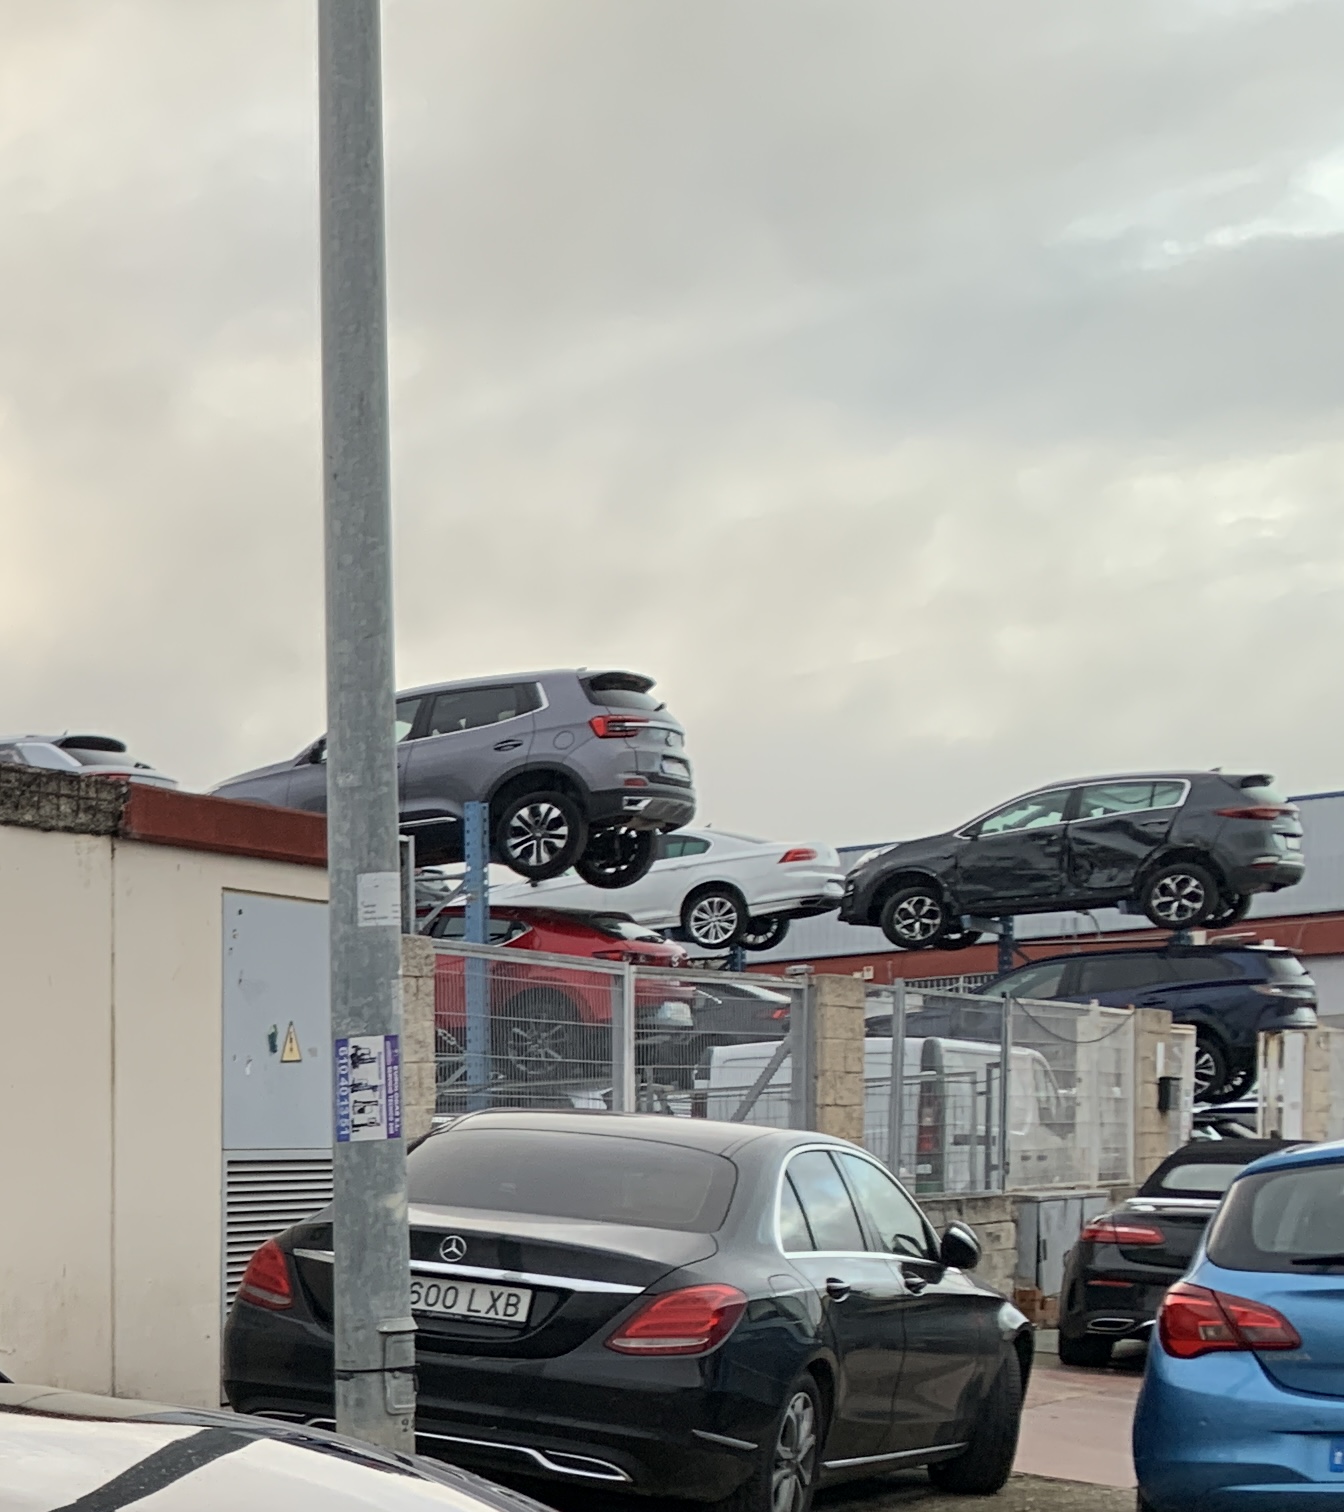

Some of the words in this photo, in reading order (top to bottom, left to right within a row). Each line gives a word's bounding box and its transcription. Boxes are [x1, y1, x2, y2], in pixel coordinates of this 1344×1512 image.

[338, 1046, 349, 1075] 610
[339, 1077, 349, 1096] 40
[467, 1288, 522, 1318] LXB
